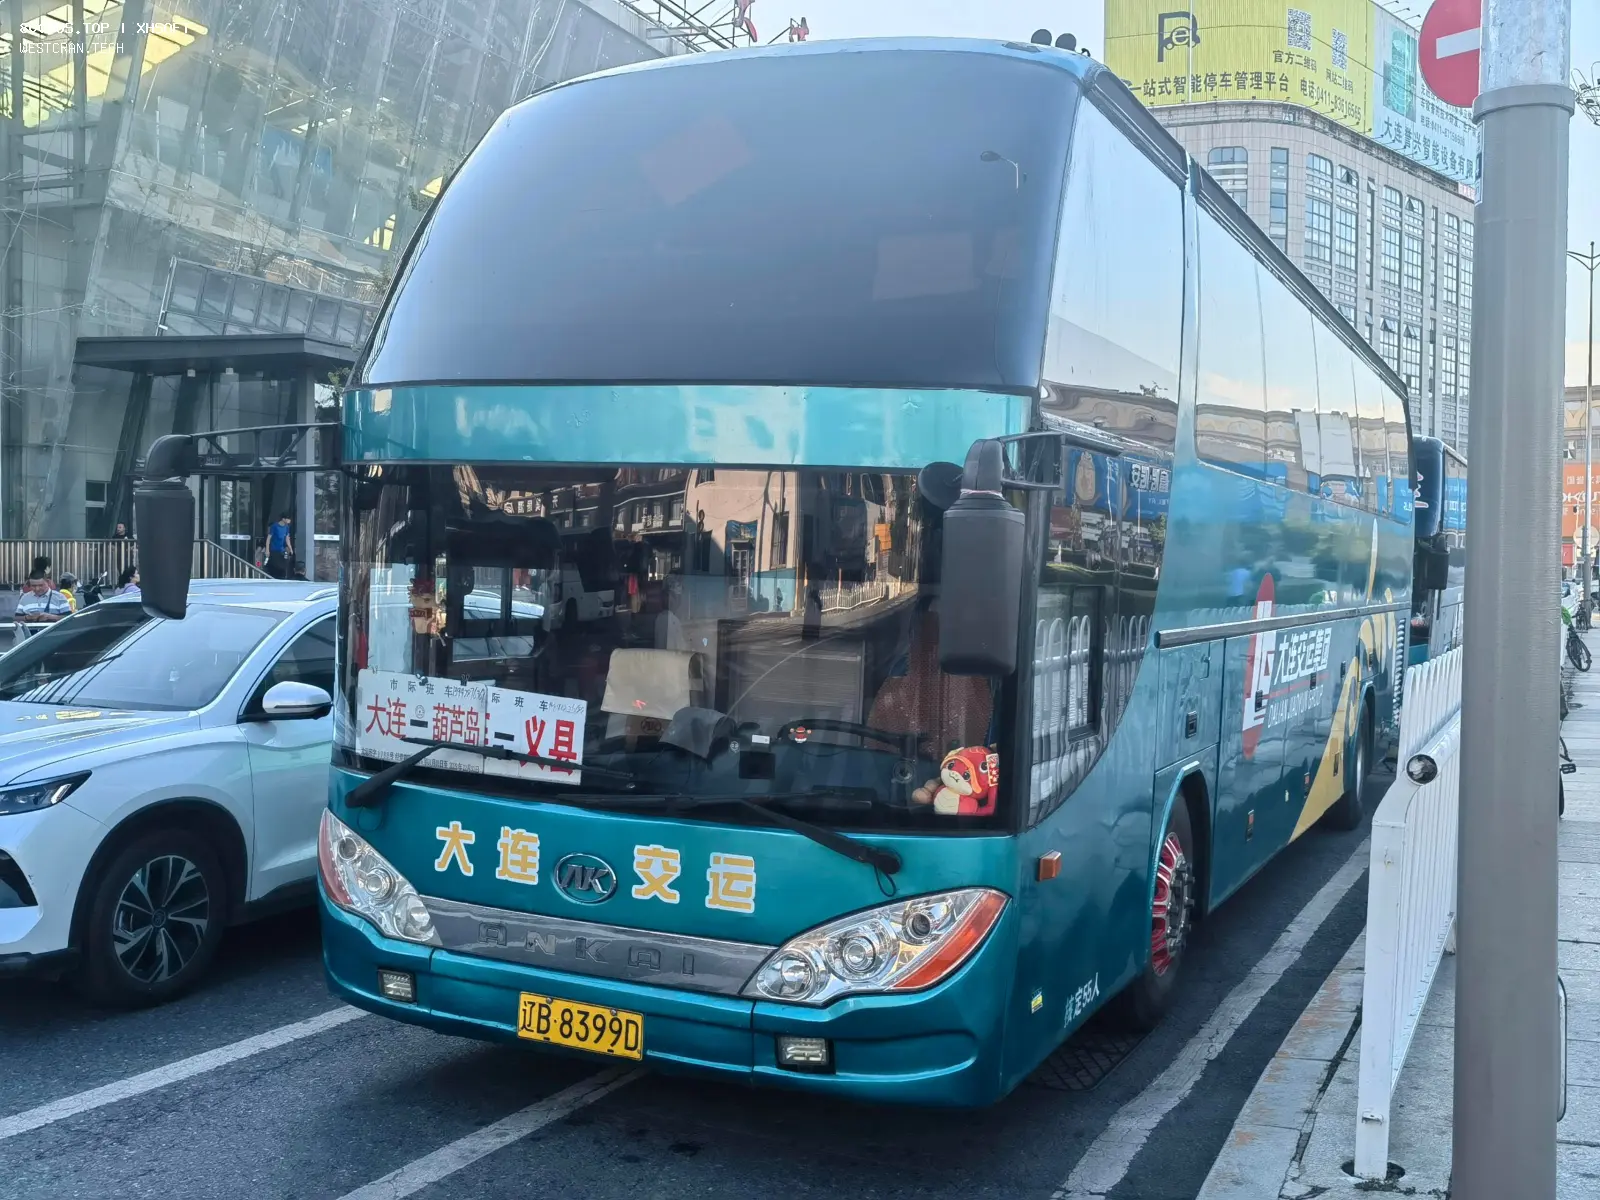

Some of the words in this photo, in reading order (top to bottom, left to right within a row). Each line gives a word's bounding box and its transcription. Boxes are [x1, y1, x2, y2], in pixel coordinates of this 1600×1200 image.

[1272, 49, 1318, 74] 官方二维码
[1129, 70, 1290, 98] 一站式智能停车管理平台
[478, 921, 695, 977] ANKAI
